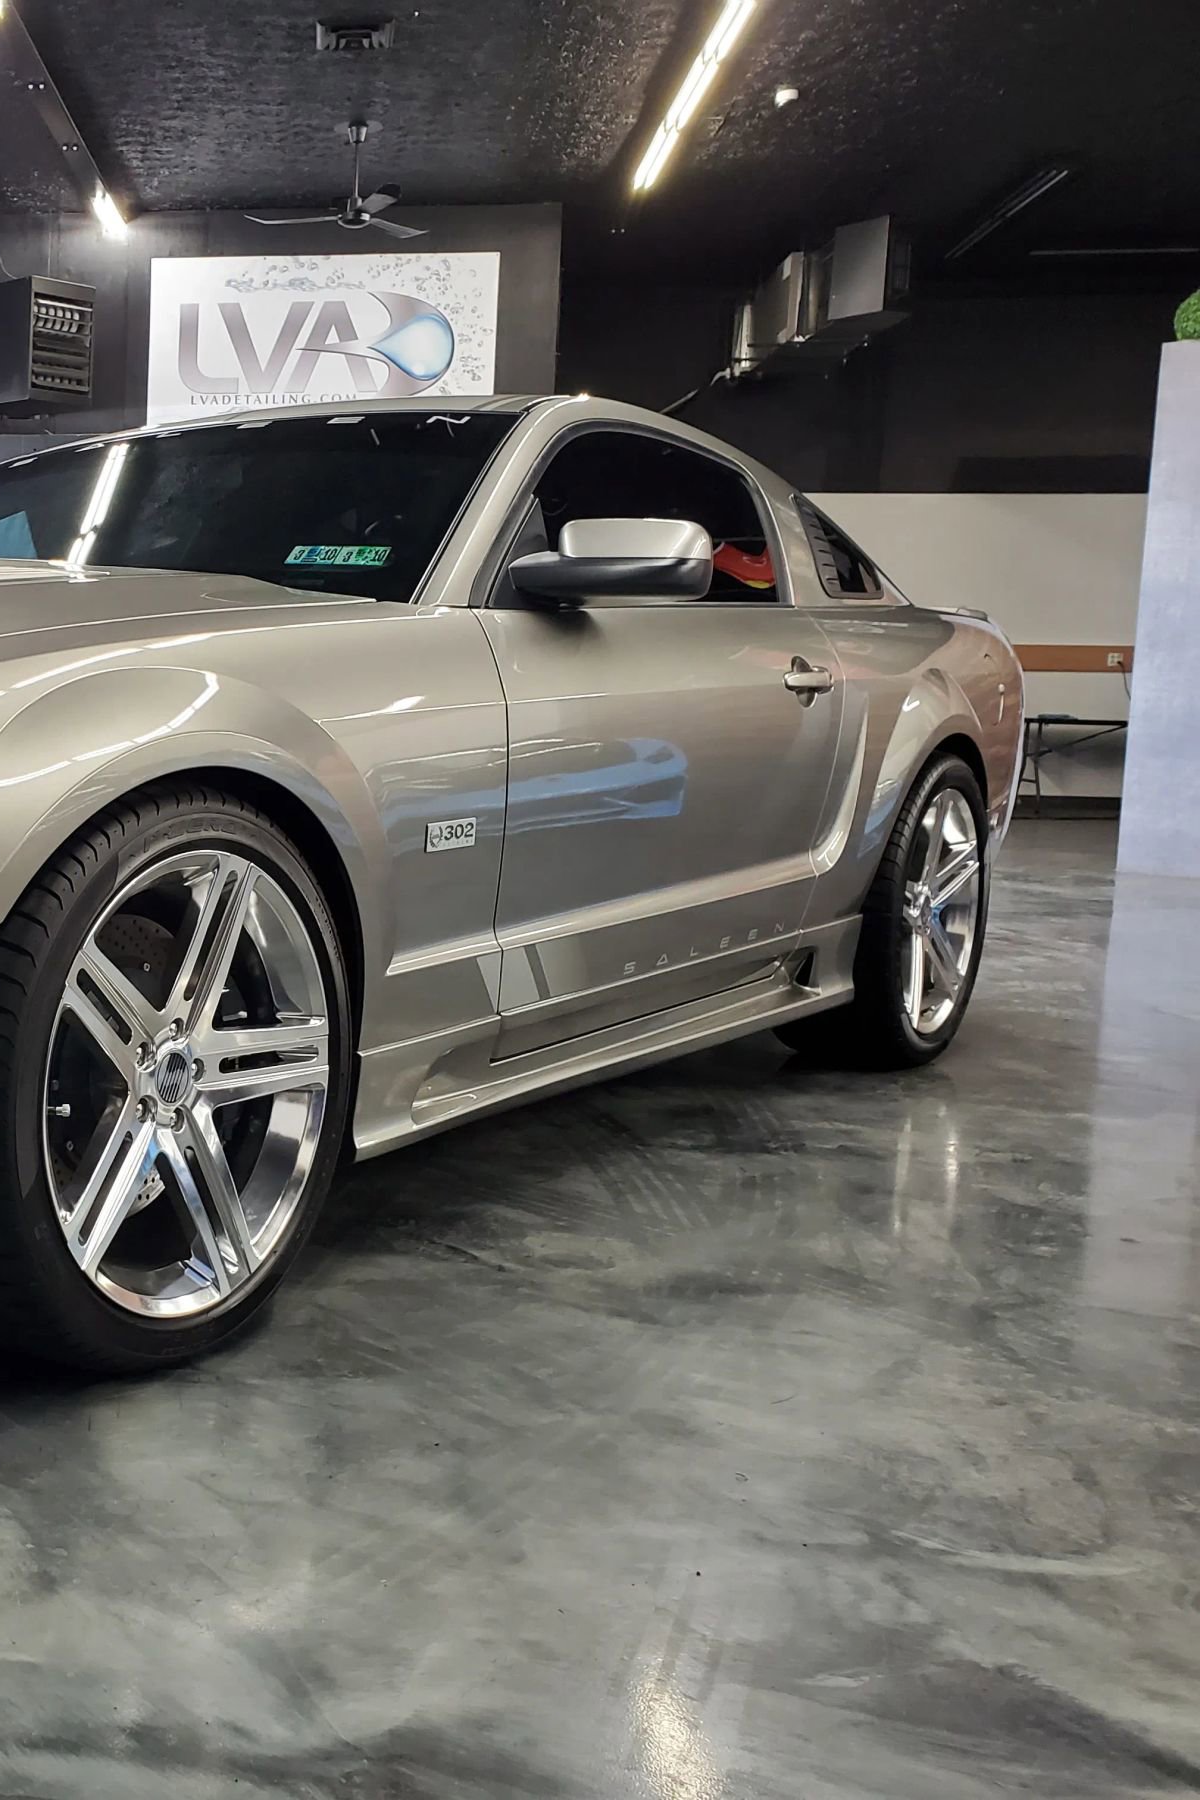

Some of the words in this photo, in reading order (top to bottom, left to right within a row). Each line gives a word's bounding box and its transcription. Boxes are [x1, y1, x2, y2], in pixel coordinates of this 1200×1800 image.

[190, 393, 357, 406] LVADETAILING.COM
[369, 549, 387, 562] 10
[444, 822, 475, 841] 302
[623, 921, 786, 976] SALEEN
